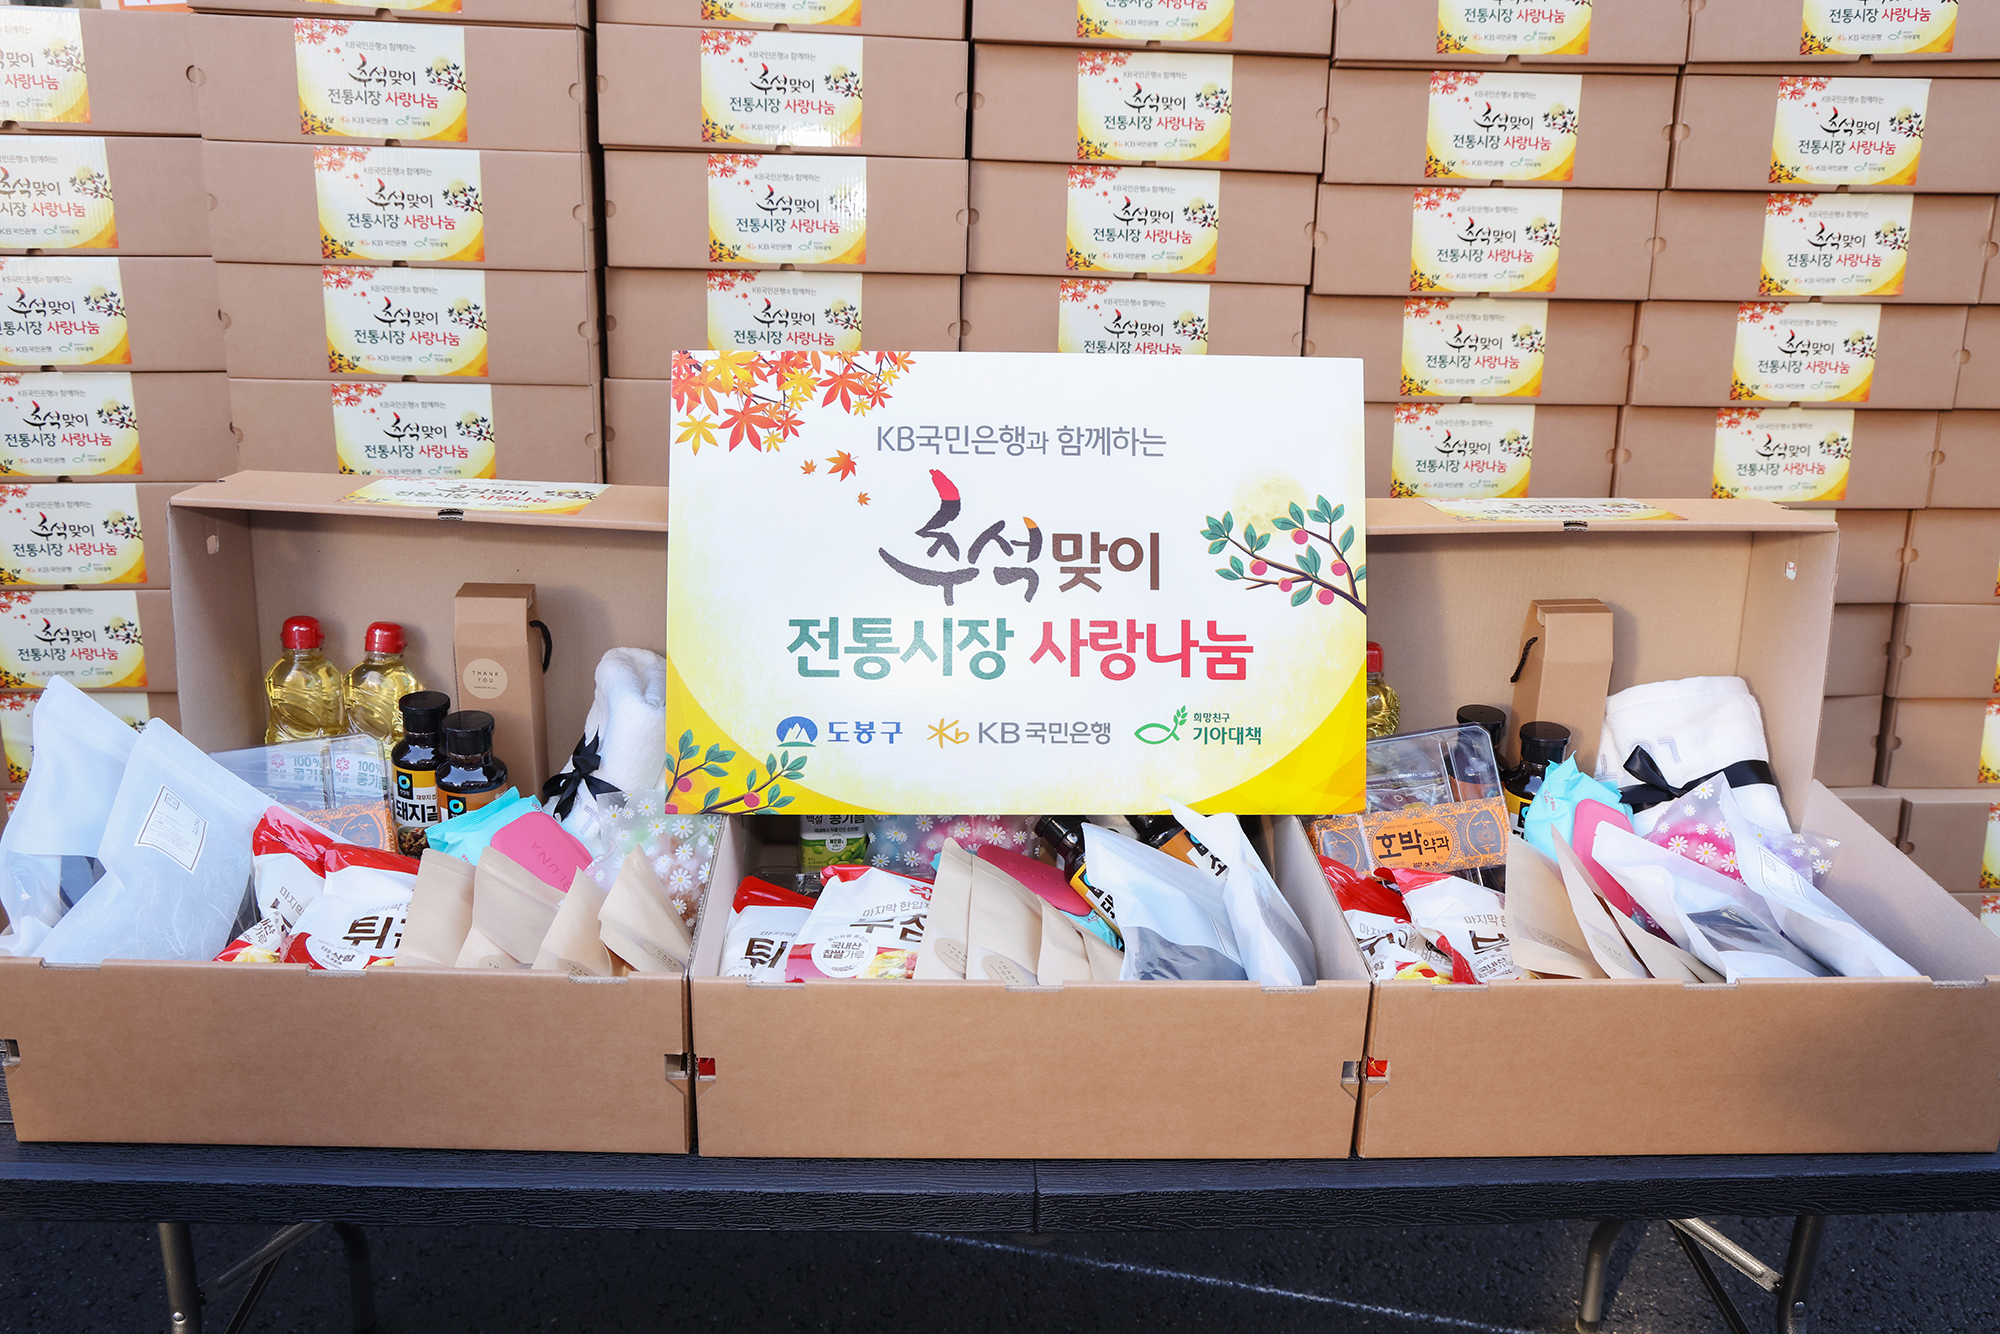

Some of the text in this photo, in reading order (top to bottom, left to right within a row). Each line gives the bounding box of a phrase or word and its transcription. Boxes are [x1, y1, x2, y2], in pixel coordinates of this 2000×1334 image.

[1464, 8, 1566, 24] 전통시장 사랑나눔
[1829, 7, 1931, 24] 전통시장 사랑나눔
[348, 53, 416, 87] 추석맞이
[750, 63, 814, 95] 추석맞이
[5, 74, 59, 90] 사랑나눔
[328, 89, 439, 109] 전통시장 사랑나눔
[729, 97, 836, 115] 전통시장 사랑나눔
[1124, 82, 1185, 113] 추석맞이
[1104, 116, 1206, 131] 전통시장 사랑나눔
[1473, 101, 1533, 132] 추석맞이
[1820, 107, 1880, 137] 추석맞이
[1453, 134, 1551, 151] 전통시장 사랑나눔
[1798, 140, 1896, 155] 전통시장 사랑나눔
[367, 178, 433, 211] 추석맞이
[756, 184, 819, 216] 추석맞이
[31, 202, 86, 217] 사랑나눔
[1113, 196, 1173, 226] 추석맞이
[347, 213, 456, 230] 전통시장 사랑나눔
[736, 218, 840, 234] 전통시장 사랑나눔
[1093, 228, 1193, 244] 전통시장 사랑나눔
[1457, 216, 1516, 246] 추석맞이
[1807, 222, 1865, 251] 추석맞이
[1437, 249, 1534, 263] 전통시장 사랑나눔
[1787, 254, 1882, 268] 전통시장 사랑나눔
[8, 287, 75, 318] 추석맞이
[374, 296, 438, 328] 추석맞이
[753, 298, 815, 328] 추석맞이
[0, 321, 100, 336] 통시장 사랑나눔
[1104, 309, 1163, 338] 추석맞이
[354, 329, 460, 347] 전통시장 사랑나눔
[734, 330, 835, 346] 전통시장 사랑나눔
[1084, 340, 1132, 354] 전통시장
[1445, 324, 1502, 353] 추석맞이
[1778, 329, 1834, 358] 추석맞이
[1426, 355, 1520, 369] 전통시장 사랑나눔
[1757, 360, 1850, 374] 전통시장 사랑나눔
[23, 400, 88, 431] 추석맞이
[383, 412, 447, 442] 추석맞이
[5, 433, 112, 448] 전통시장 사랑나눔
[878, 425, 1166, 457] KB국민은행과 함께하는
[1435, 430, 1490, 457] 추석맞이
[1755, 433, 1810, 461] 추석맞이
[365, 445, 469, 459] 전통시장 사랑나눔
[1416, 460, 1508, 473] 전통시장 사랑나눔
[1736, 462, 1827, 476] 전통시장 사랑나눔
[30, 512, 94, 541] 추석맞이
[878, 469, 1159, 606] 추석맞이
[13, 543, 117, 557] 전통시장 사랑나눔
[35, 618, 96, 646] 추석맞이
[18, 648, 118, 662] 전통시장 사랑나눔
[787, 617, 1253, 681] 전통시장 사랑나눔
[1194, 713, 1230, 723] 희망친구
[828, 721, 902, 744] 도봉구
[1193, 727, 1261, 745] 기아대책
[863, 903, 898, 917] 마지막
[1464, 914, 1499, 926] 마지막
[823, 949, 865, 960] 찹쌀가루
[831, 942, 862, 951] 국내산
